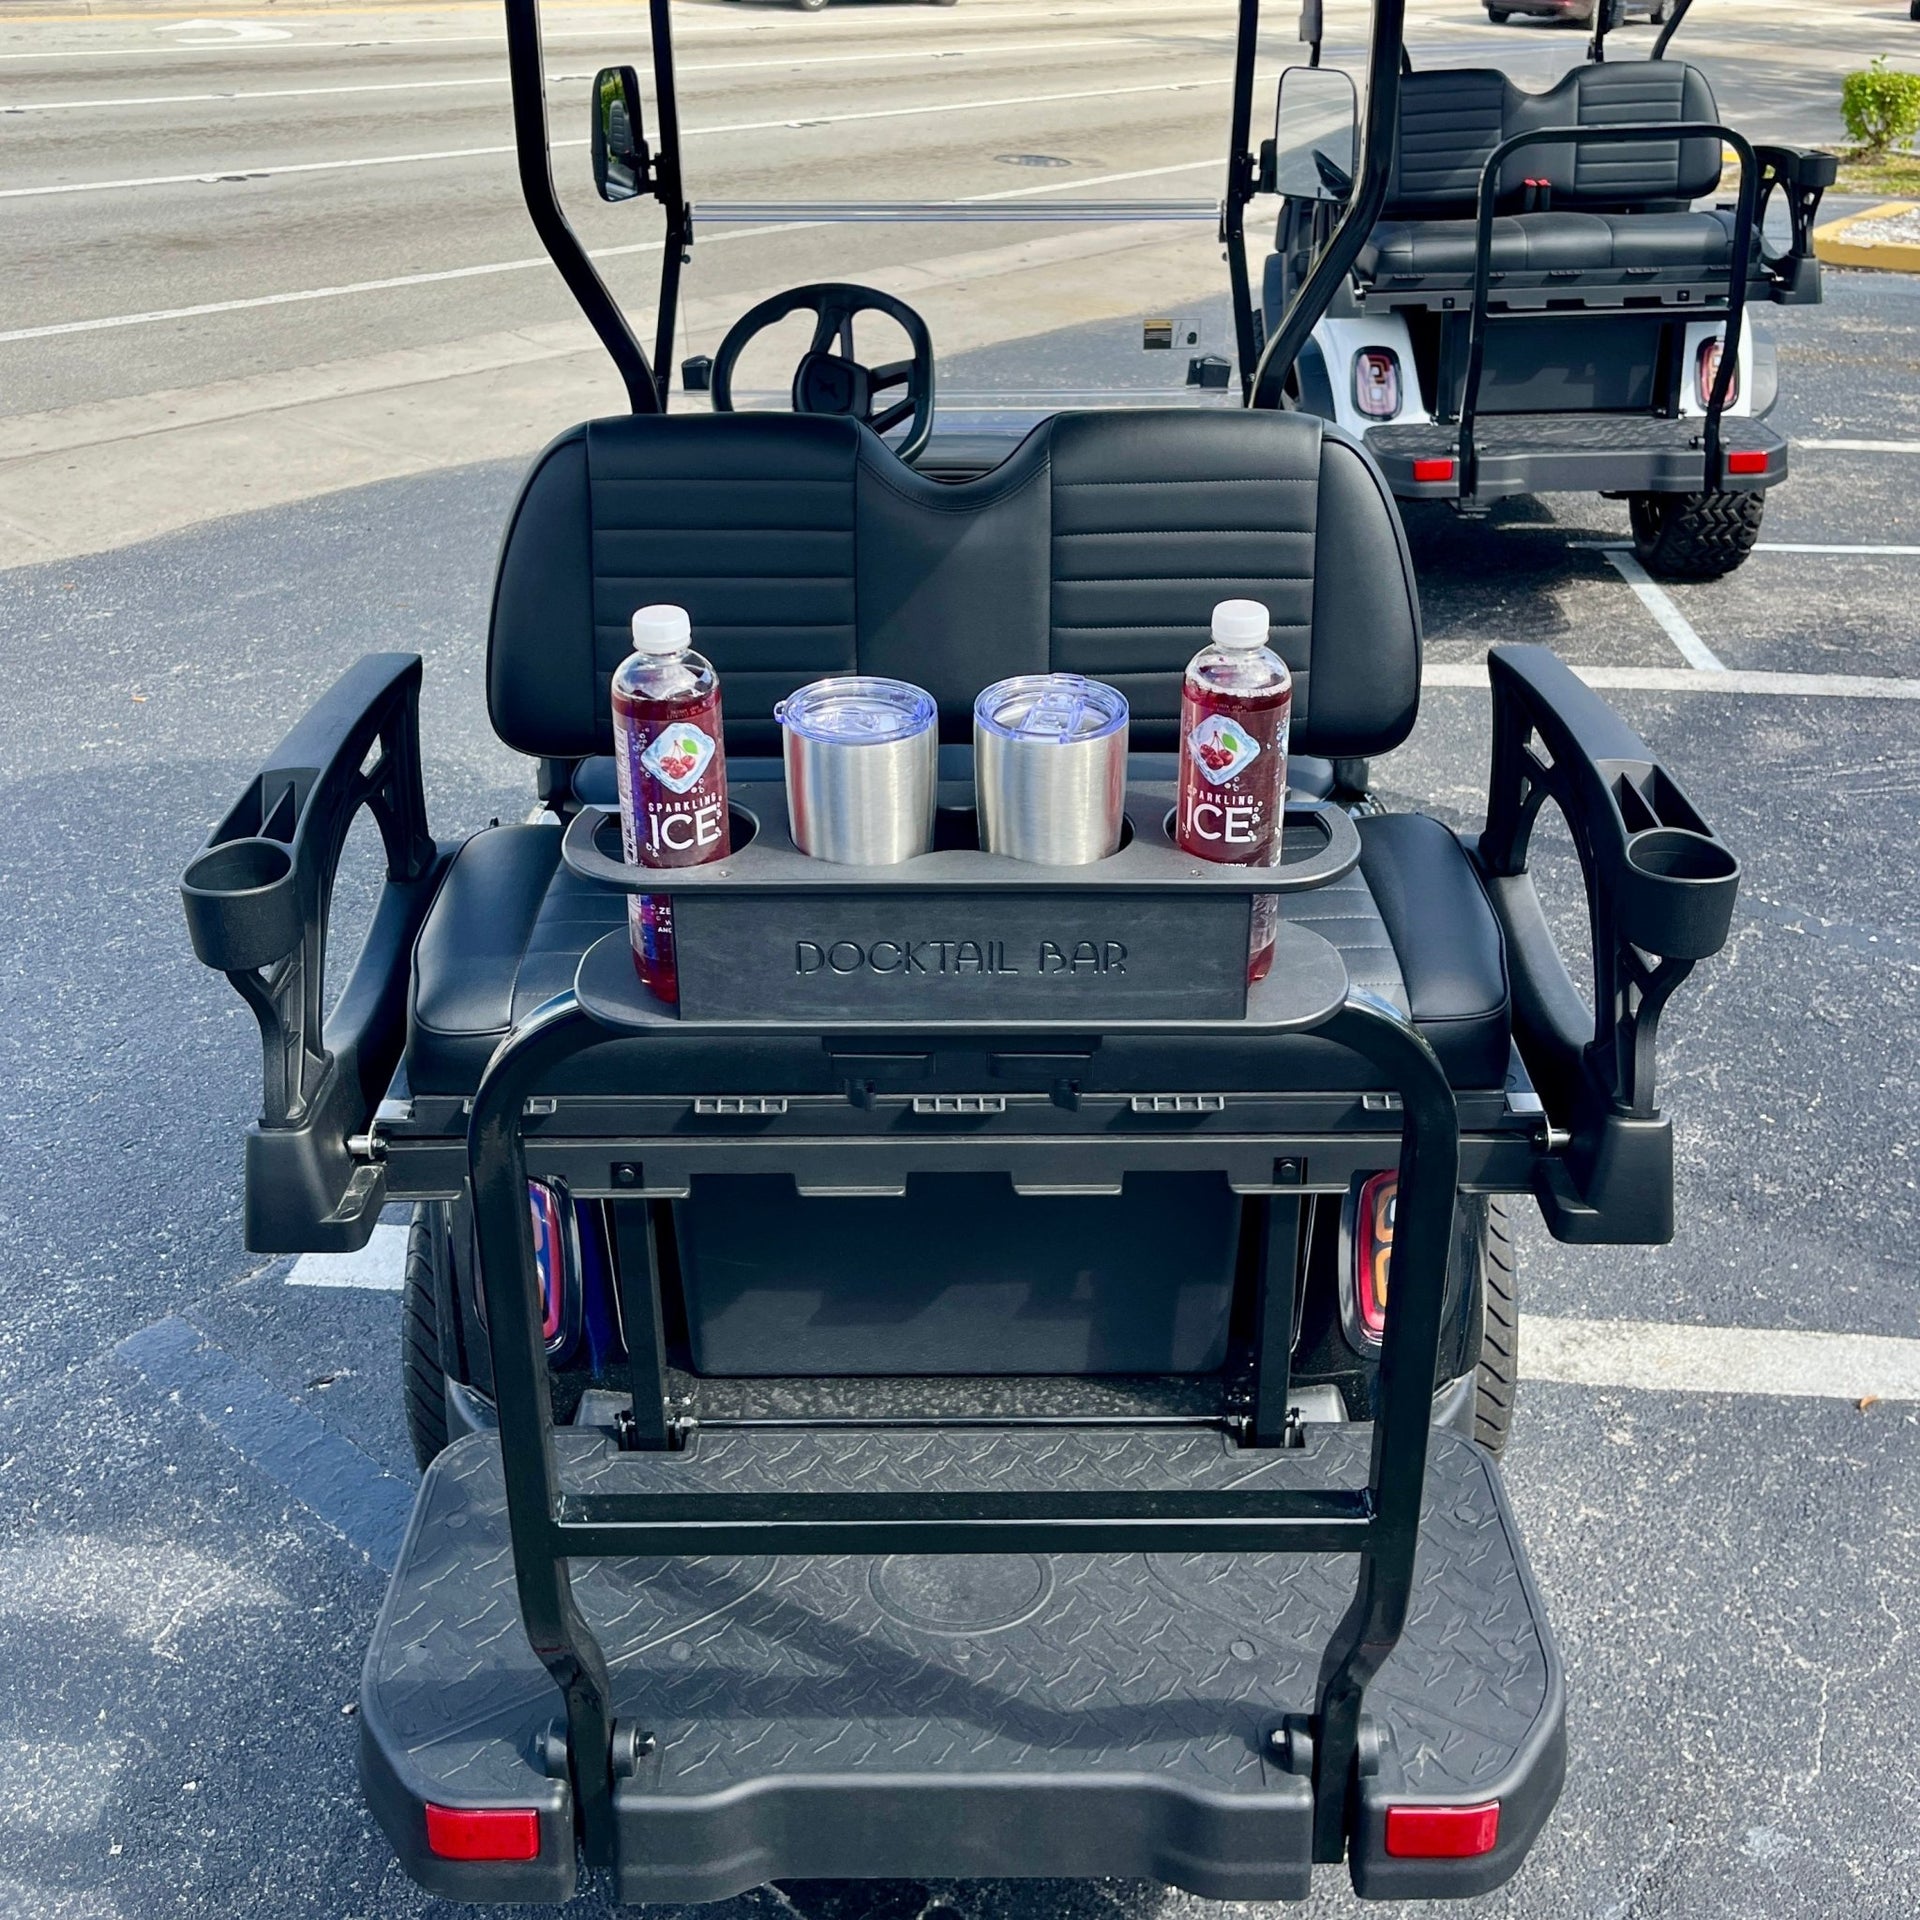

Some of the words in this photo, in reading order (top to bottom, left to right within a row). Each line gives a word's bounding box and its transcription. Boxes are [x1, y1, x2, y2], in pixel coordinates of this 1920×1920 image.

[648, 792, 716, 813] SPARKLING
[1187, 784, 1254, 806] SPARKLING
[649, 803, 719, 850] ICE
[1186, 796, 1253, 843] ICE
[795, 940, 1019, 975] DOCKTAIL
[1038, 940, 1129, 975] BAR
